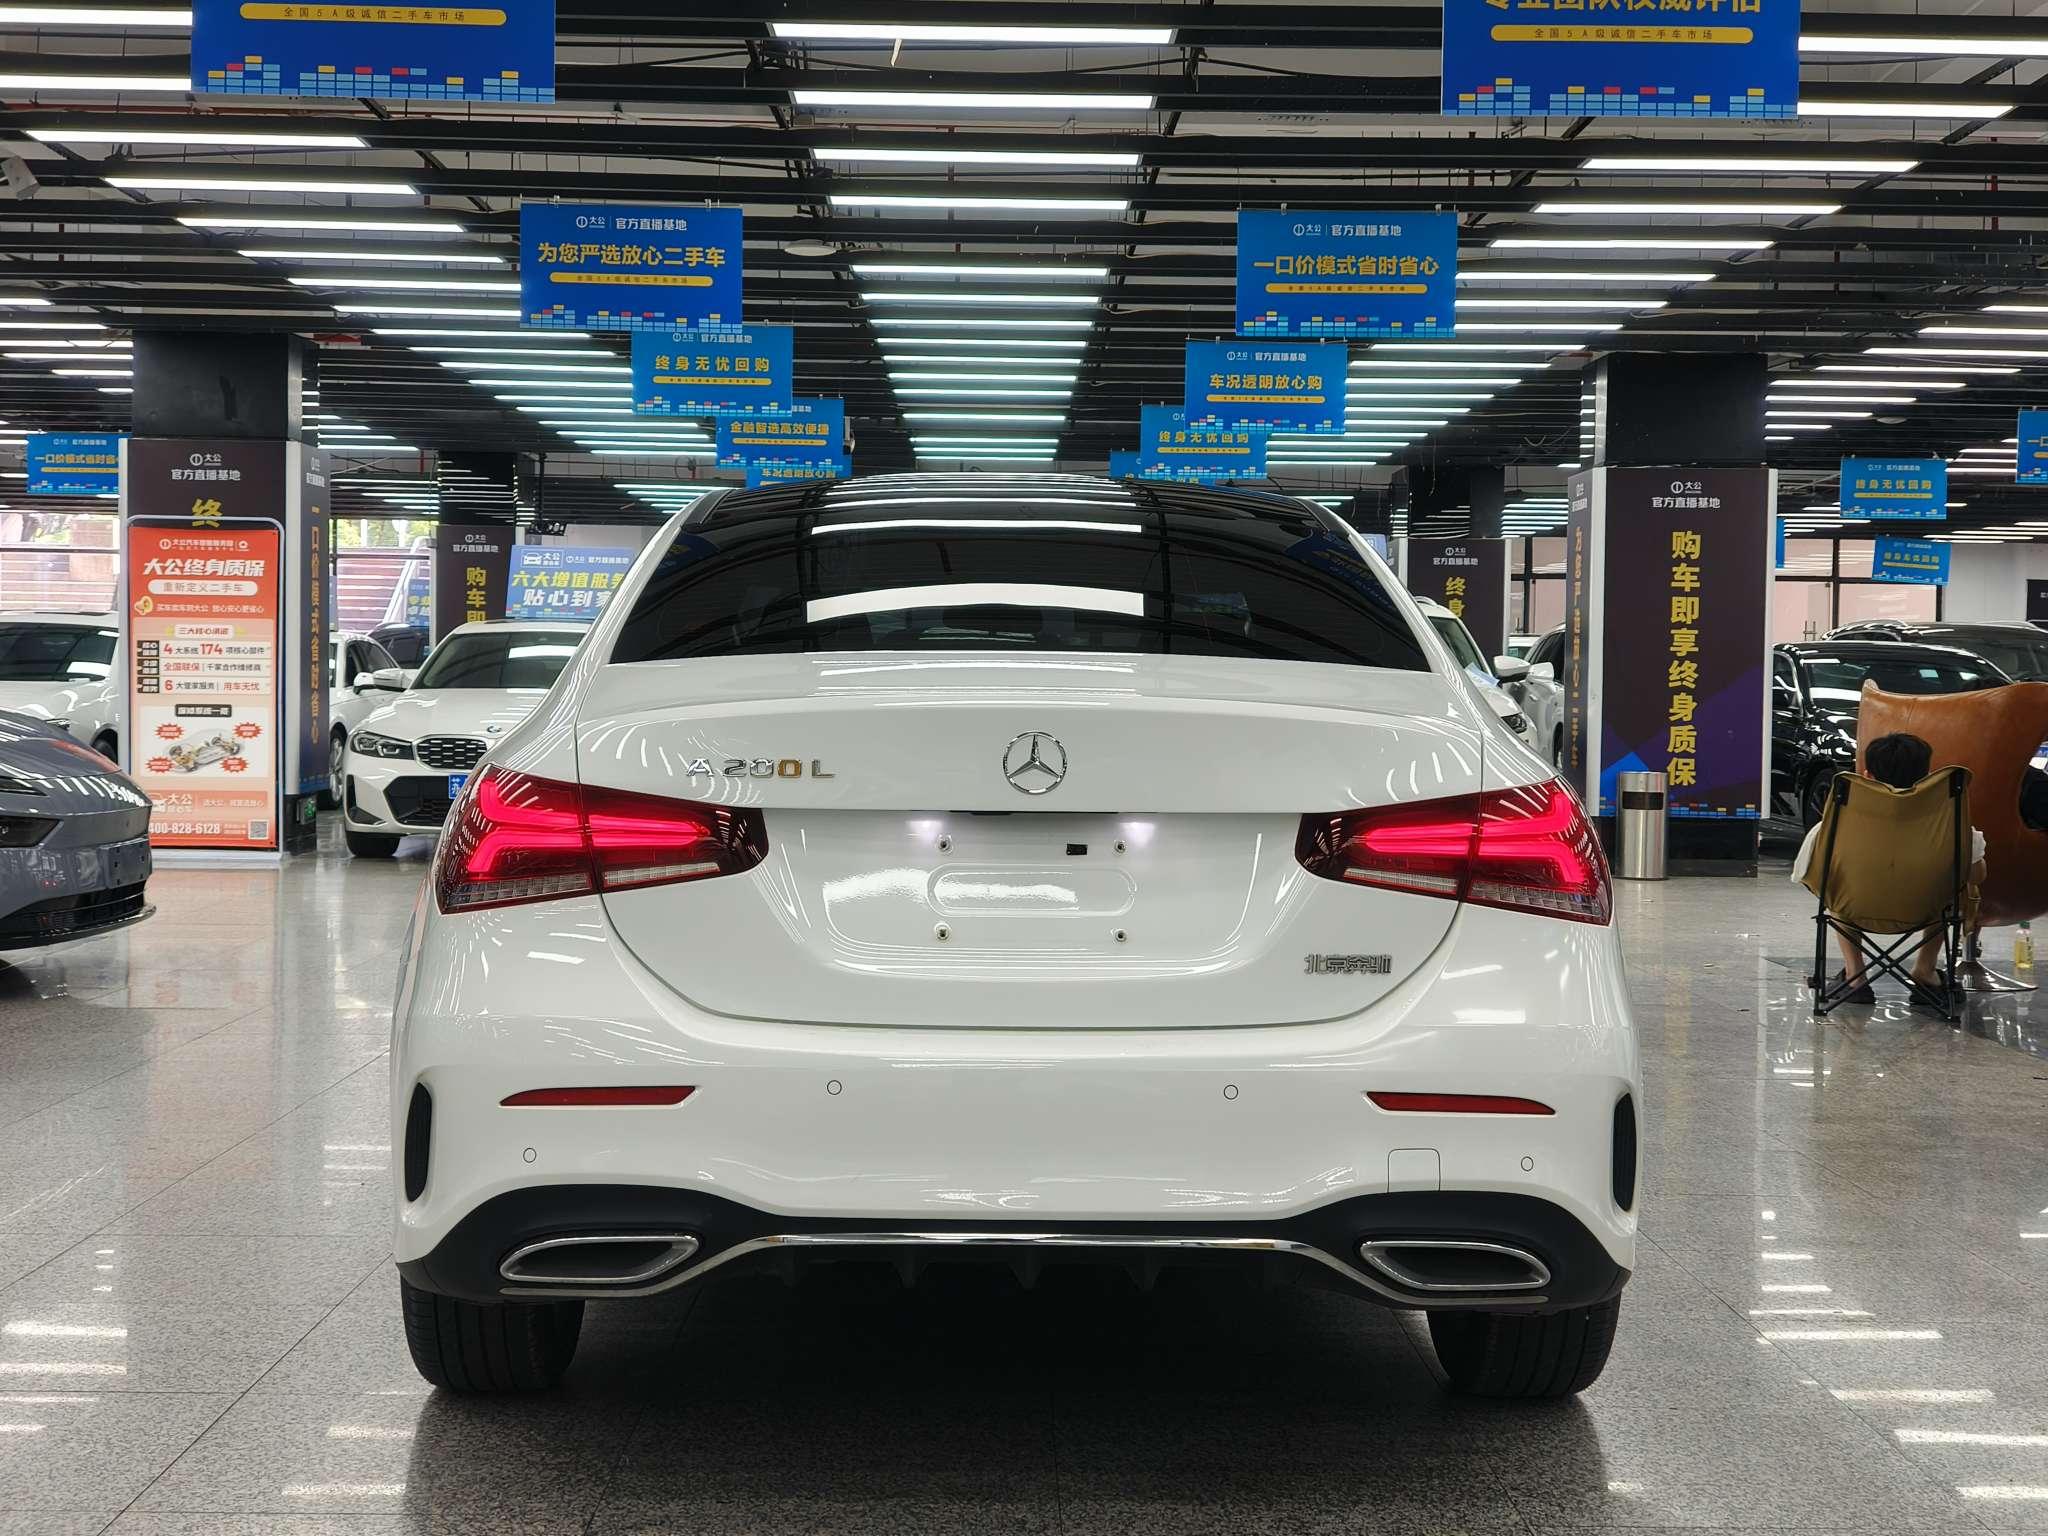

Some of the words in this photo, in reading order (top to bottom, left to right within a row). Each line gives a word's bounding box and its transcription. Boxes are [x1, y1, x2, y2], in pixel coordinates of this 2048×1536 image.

[616, 218, 688, 231] 官方直播基地
[1331, 225, 1402, 237] 官方直播基地
[538, 243, 725, 268] 为您严选放心二手车
[1254, 255, 1440, 275] 一口价模式省时省心
[655, 355, 769, 372] 终身无忧回购
[1209, 373, 1323, 390] 车况透明放心购
[204, 453, 222, 462] 大公
[171, 469, 241, 481] 官方直播基地
[1684, 482, 1702, 490] 大公
[1651, 496, 1720, 508] 官方直播基地
[192, 499, 223, 528] 终
[143, 558, 265, 577] 大公终身质保
[163, 583, 244, 593] 重新定义二手车
[200, 644, 223, 655] 174
[1667, 531, 1701, 786] 购车即享终身质保
[168, 793, 192, 805] 大公
[1304, 954, 1392, 974] 北京奔驰
